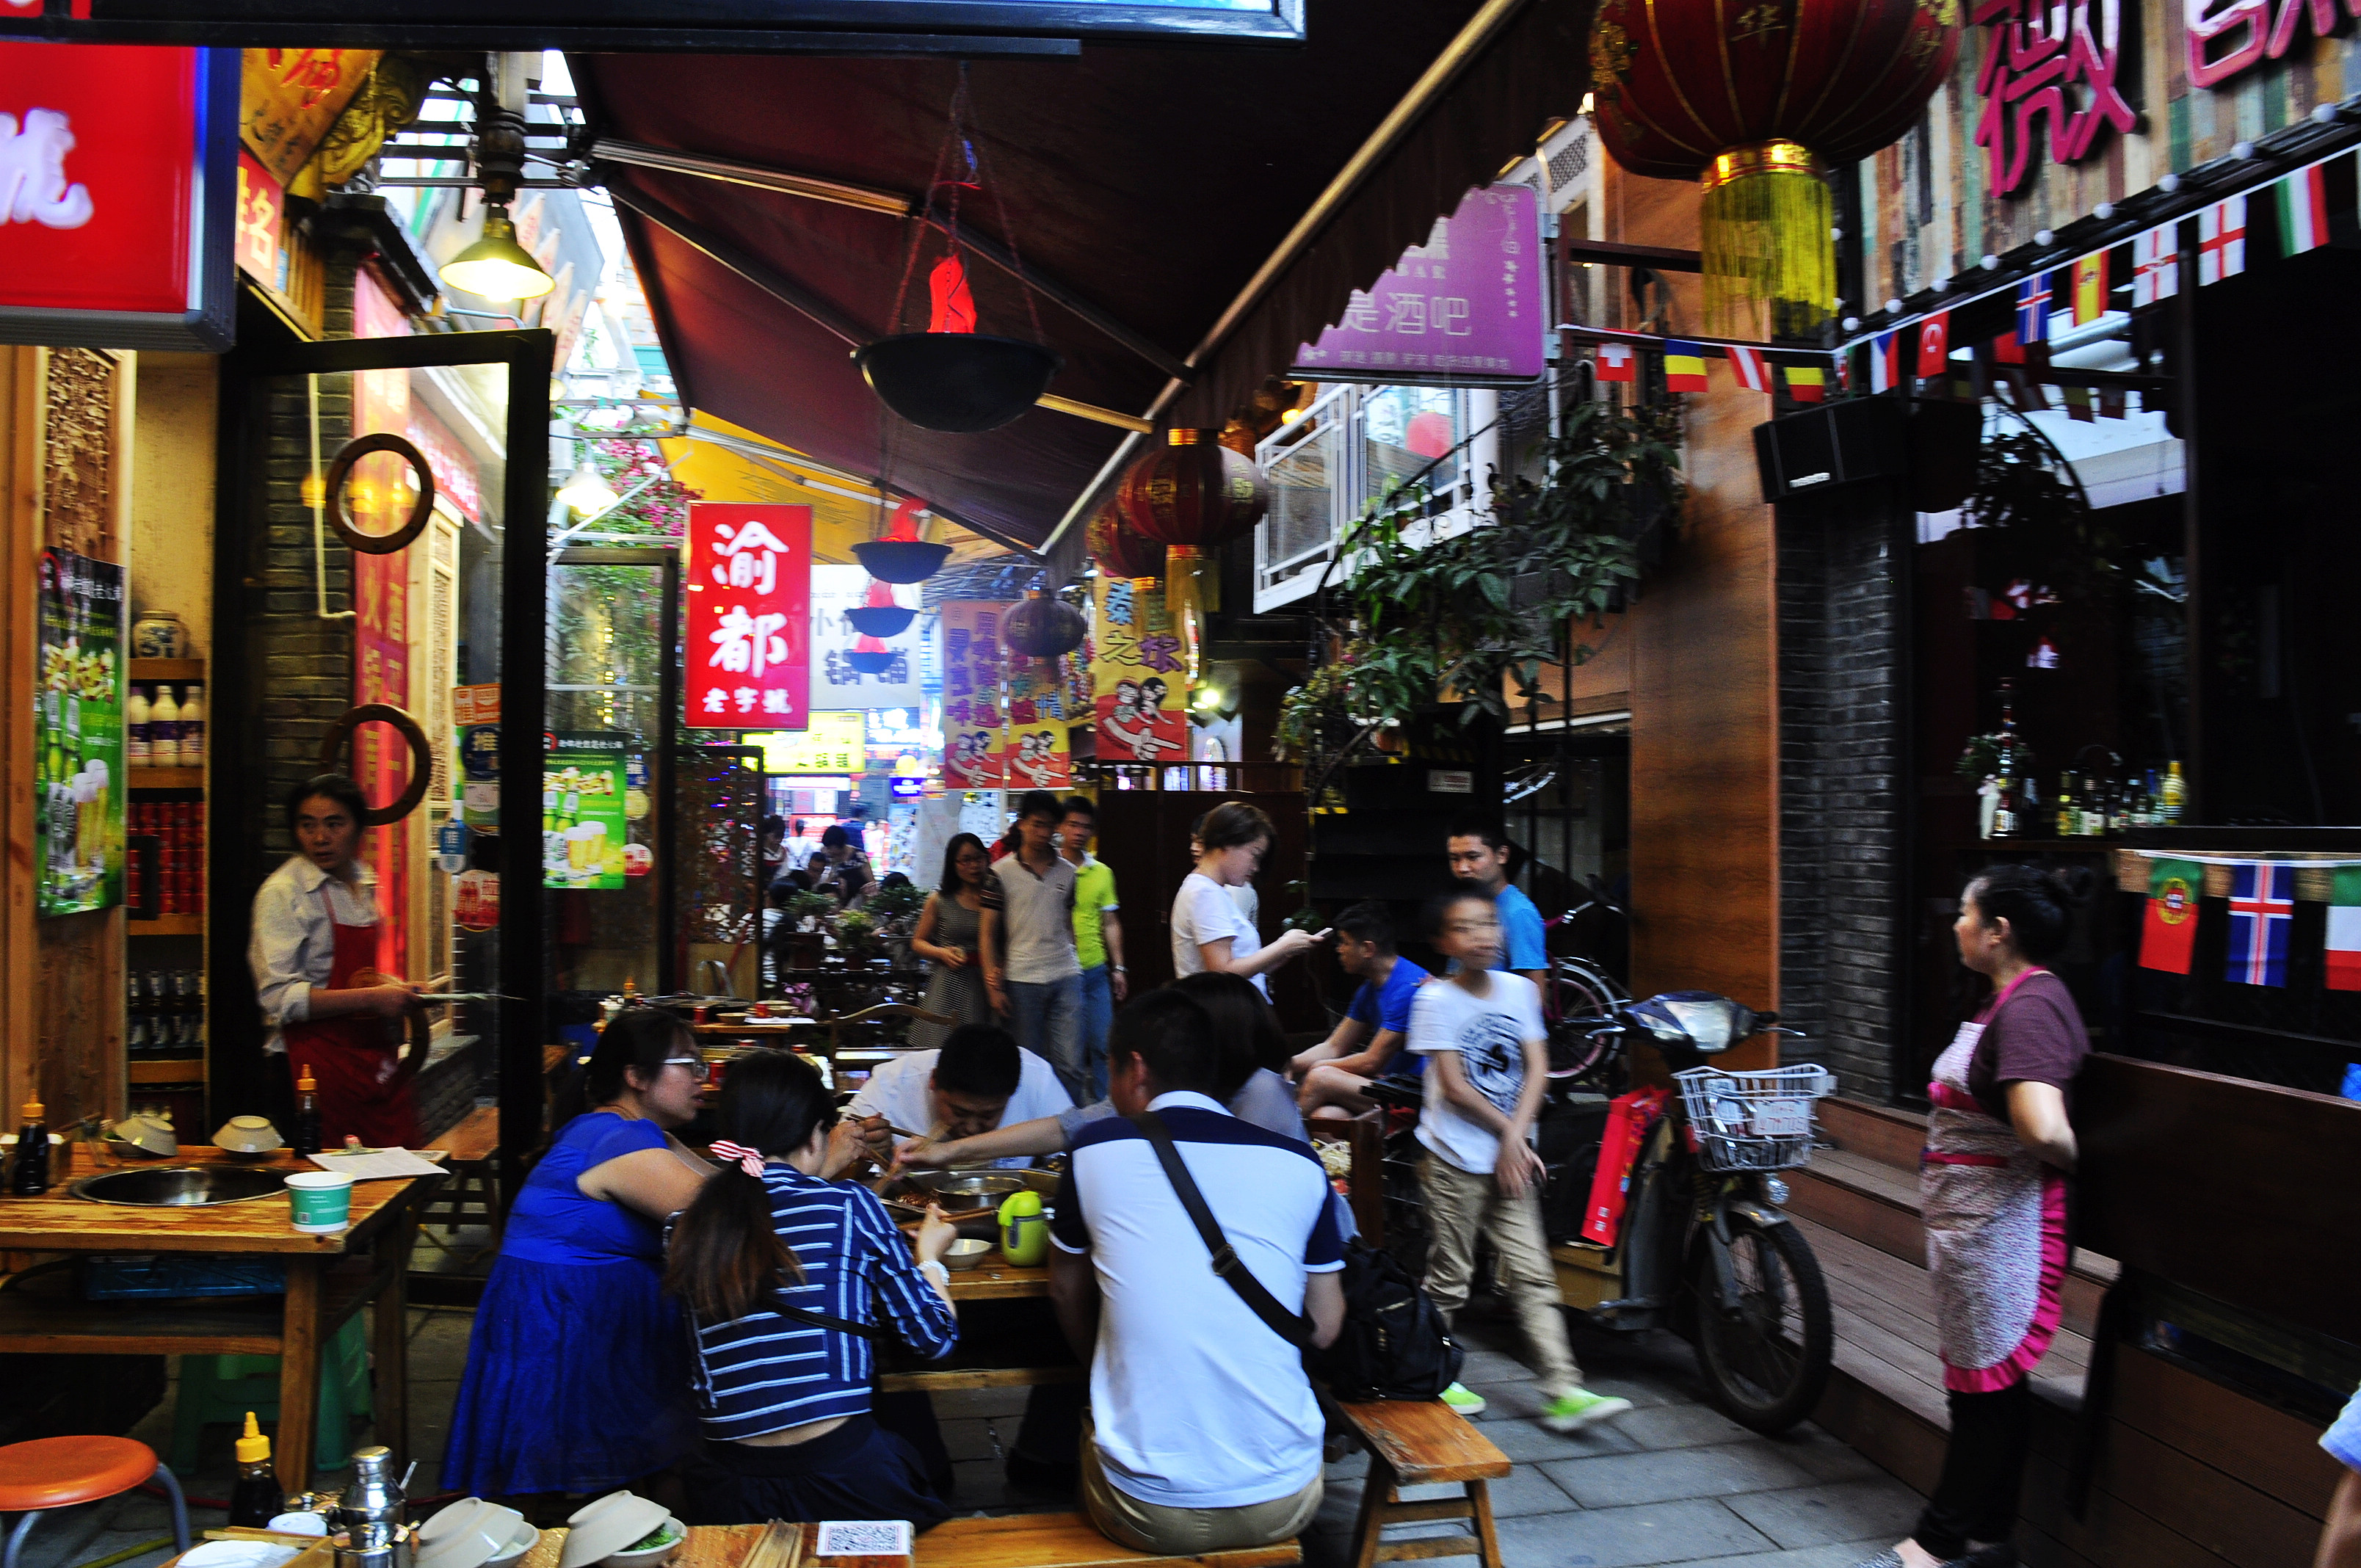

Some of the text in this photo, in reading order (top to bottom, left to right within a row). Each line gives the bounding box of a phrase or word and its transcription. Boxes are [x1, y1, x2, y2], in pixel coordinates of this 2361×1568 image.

[1325, 288, 1472, 337] 是酒吧
[708, 520, 790, 678] 渝都
